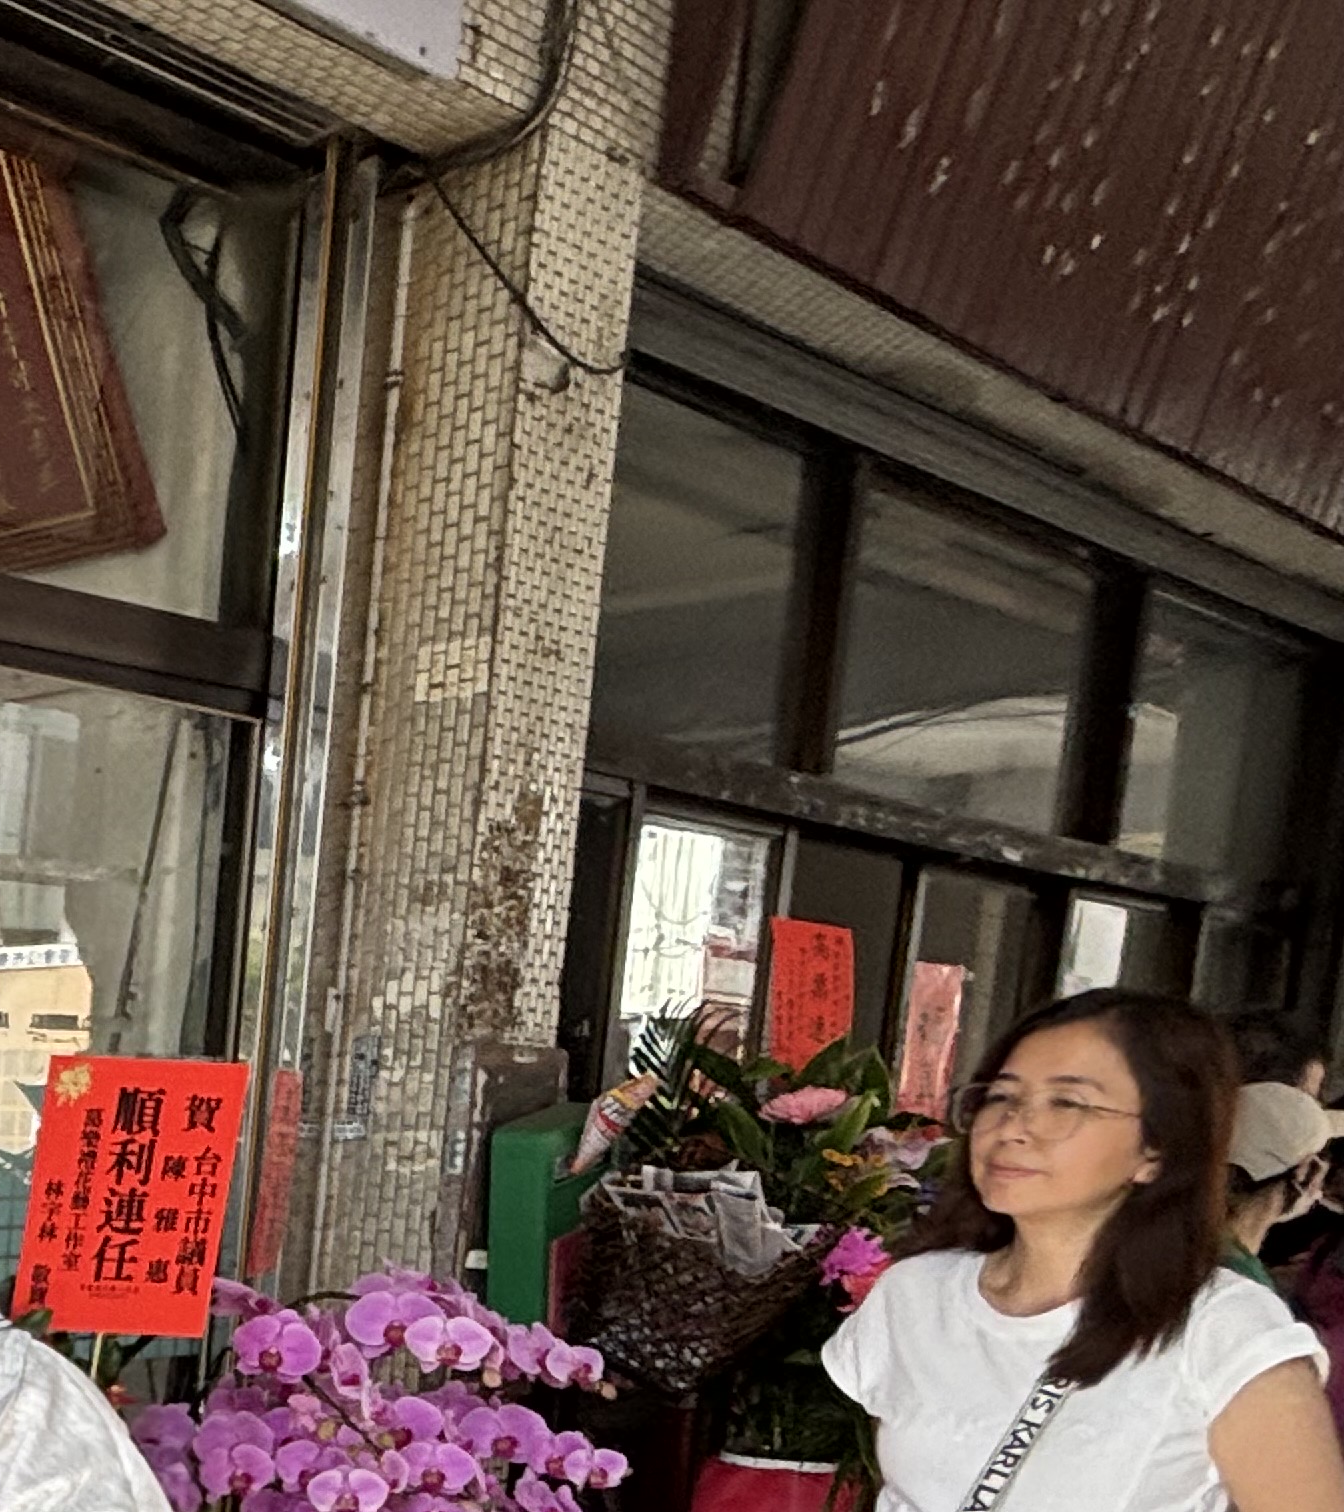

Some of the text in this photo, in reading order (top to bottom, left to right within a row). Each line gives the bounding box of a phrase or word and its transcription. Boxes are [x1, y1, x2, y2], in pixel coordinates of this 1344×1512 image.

[92, 1087, 166, 1282] 順利連任
[172, 1095, 222, 1295] 賀 台中市議員
[984, 1418, 1041, 1479] KARL
